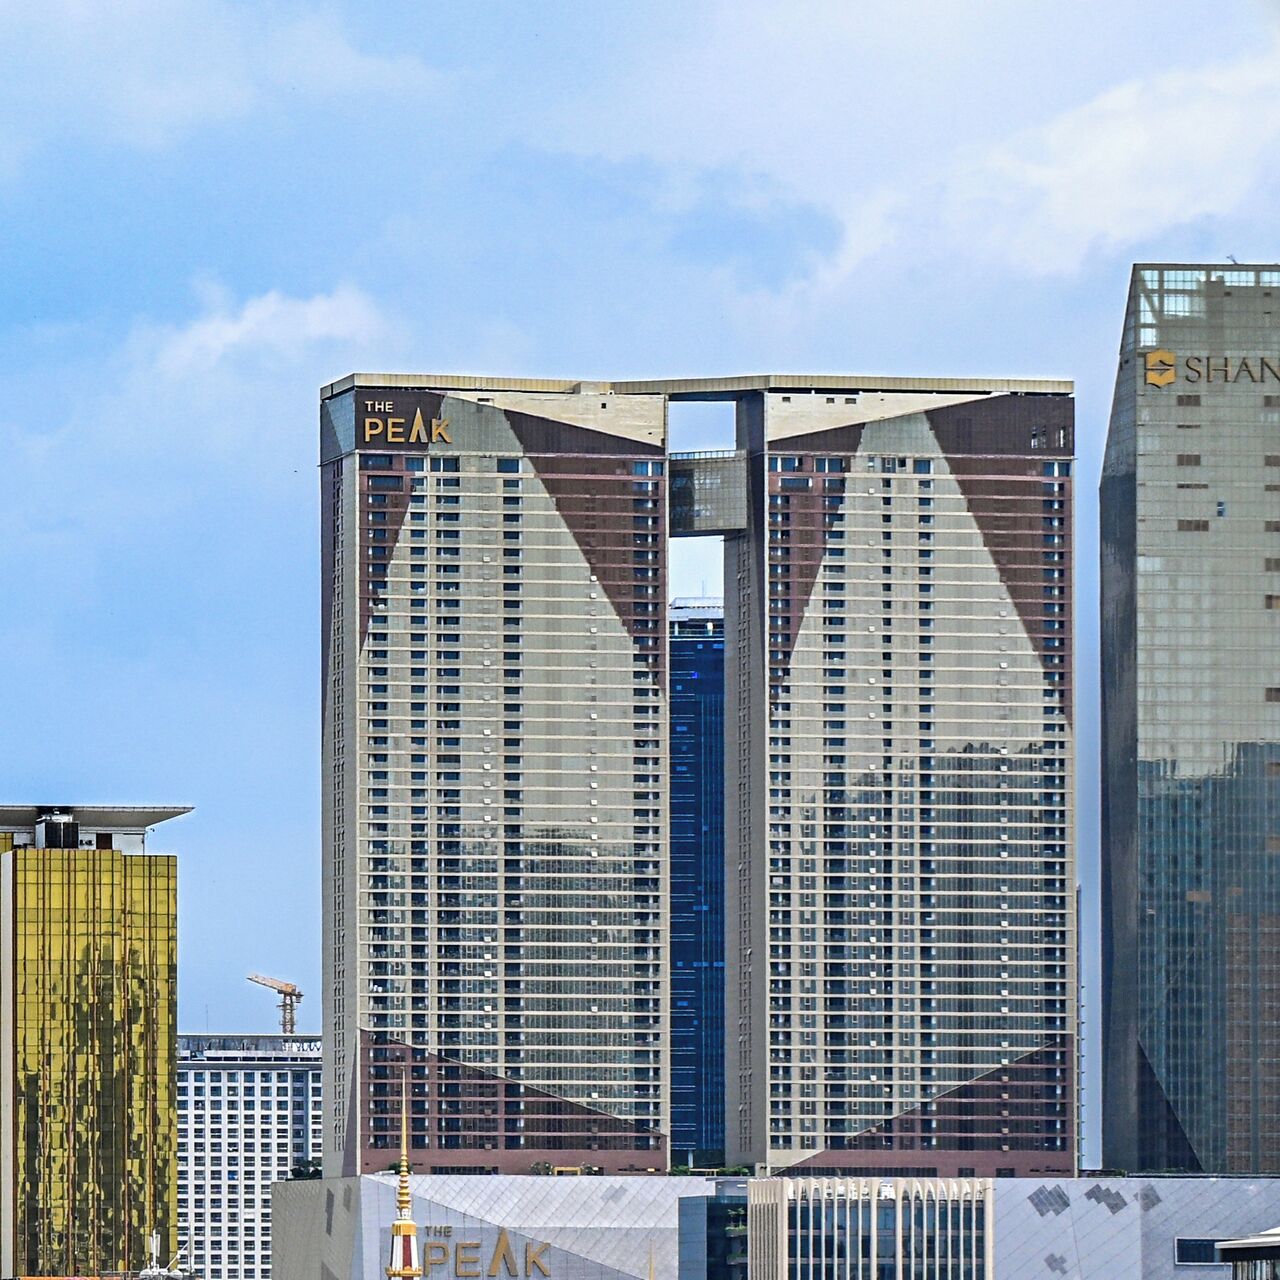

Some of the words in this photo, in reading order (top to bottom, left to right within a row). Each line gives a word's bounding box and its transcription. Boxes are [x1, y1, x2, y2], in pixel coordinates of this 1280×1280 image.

[1184, 356, 1280, 383] SHAN
[364, 401, 394, 412] THE
[364, 407, 452, 442] PEAK
[425, 1225, 452, 1237] THE
[423, 1227, 551, 1277] PEAK
